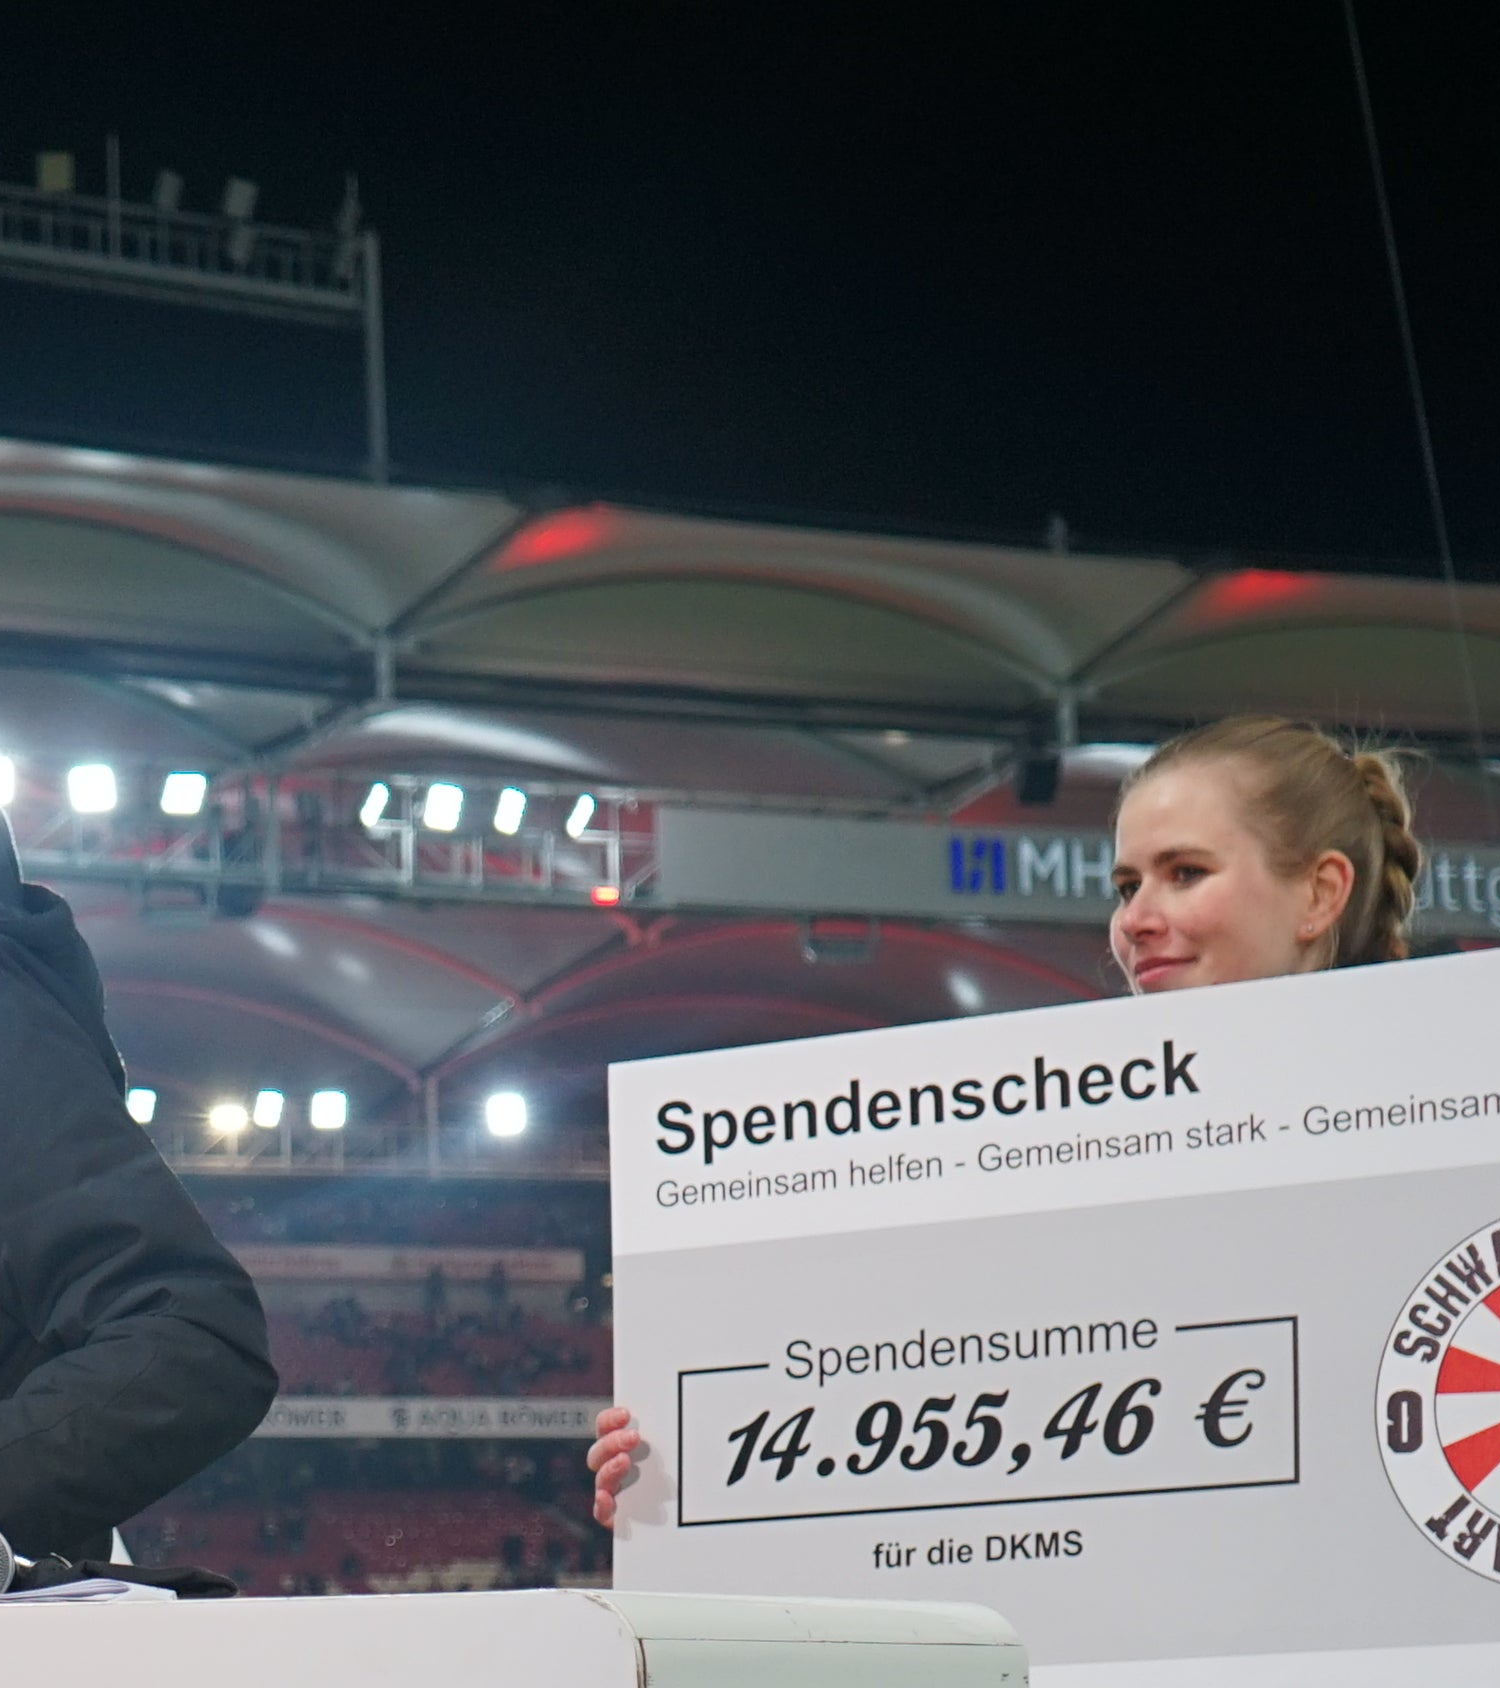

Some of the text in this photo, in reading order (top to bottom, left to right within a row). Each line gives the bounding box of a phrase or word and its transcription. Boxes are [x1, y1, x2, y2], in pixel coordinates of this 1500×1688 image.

[1018, 836, 1113, 899] MH
[655, 1040, 1200, 1164] Spendenscheck
[655, 1168, 838, 1208] Gemeinsam
[848, 1153, 943, 1188] helfen
[977, 1127, 1174, 1172] Gemeinsam
[1186, 1113, 1267, 1150] stark
[784, 1316, 1158, 1386] Spendensumme
[725, 1367, 1266, 1487] 14.955,46 €
[872, 1529, 1084, 1569] für die DKMS
